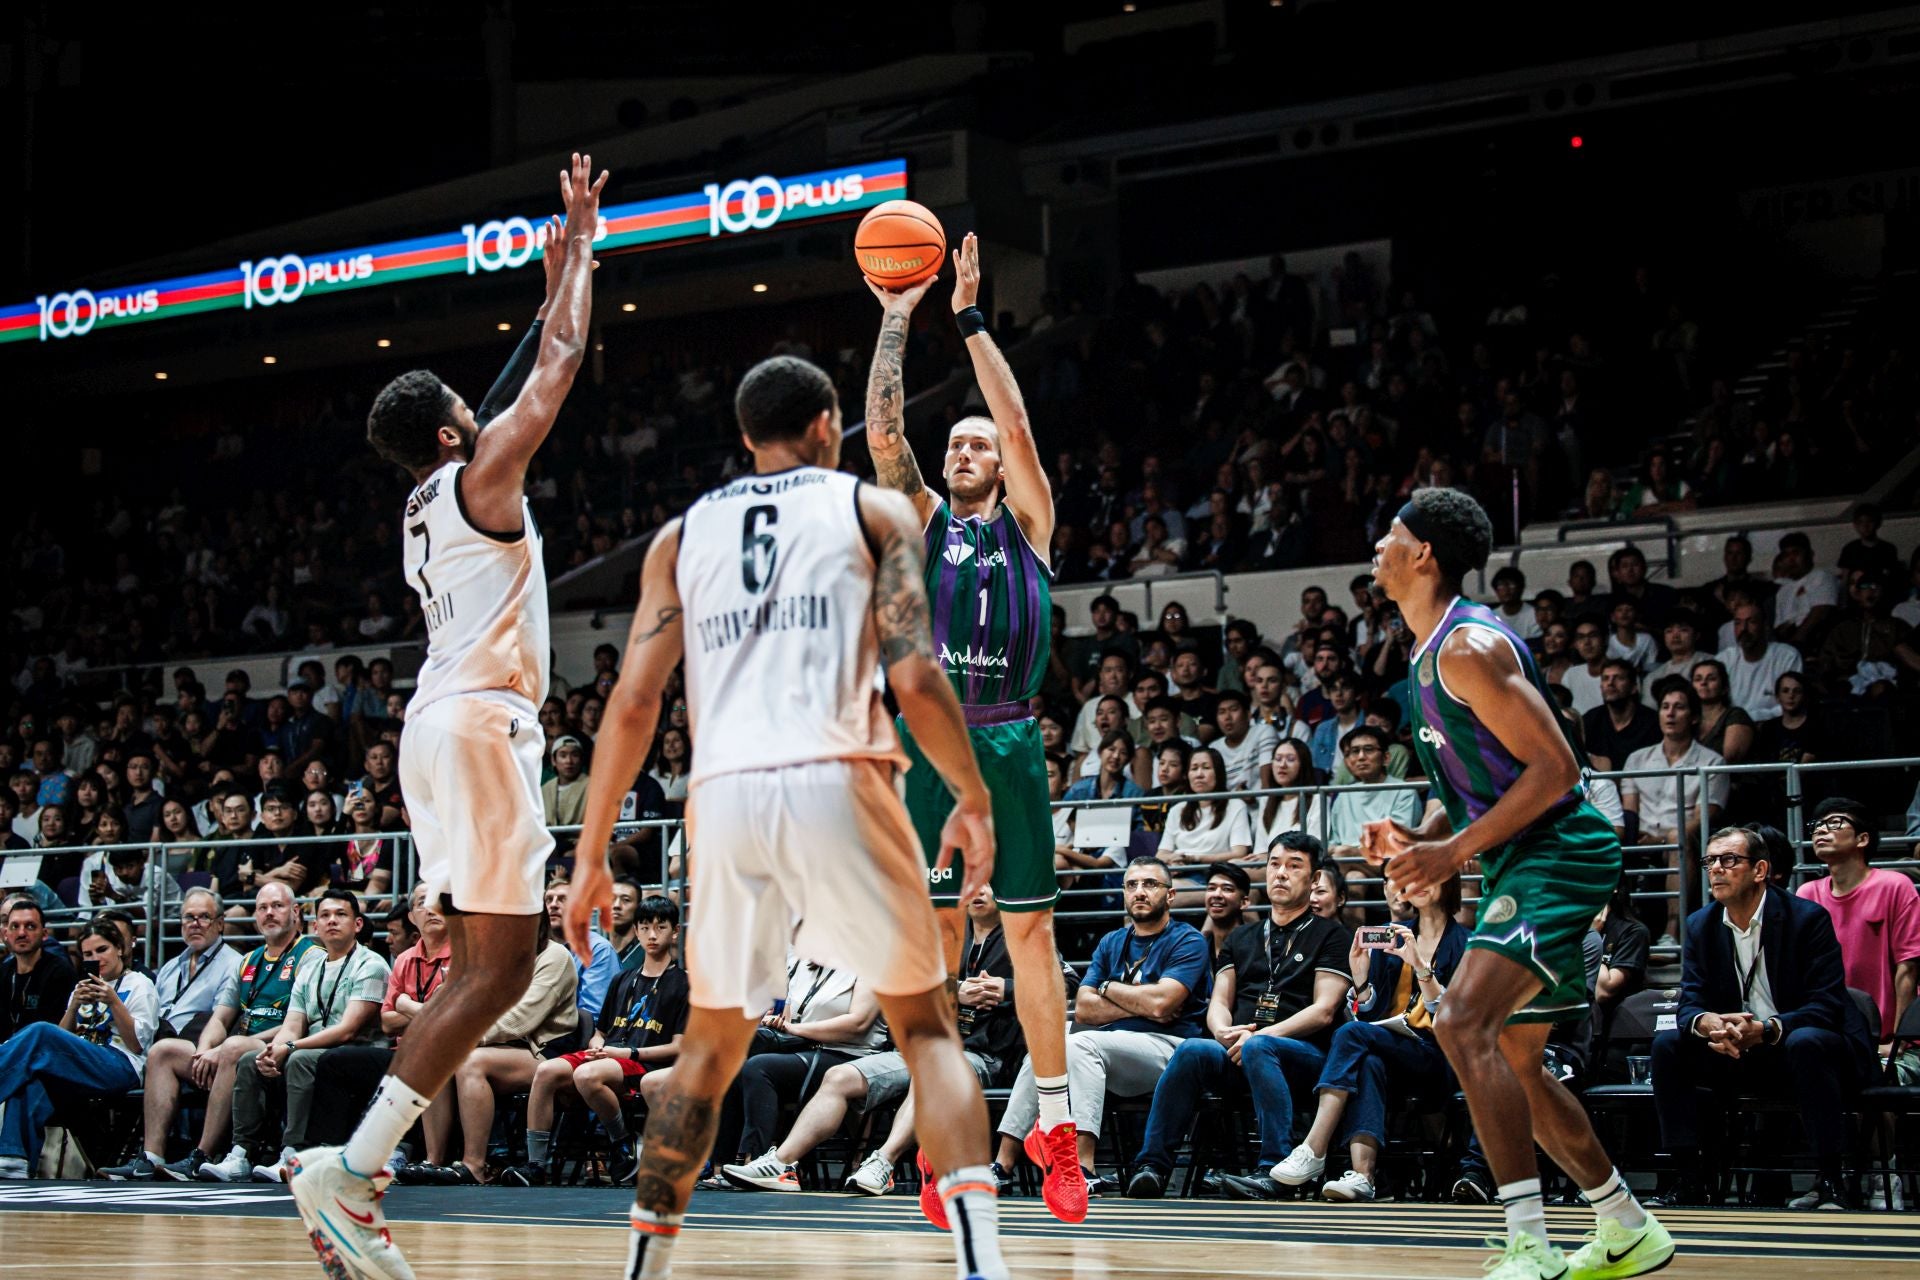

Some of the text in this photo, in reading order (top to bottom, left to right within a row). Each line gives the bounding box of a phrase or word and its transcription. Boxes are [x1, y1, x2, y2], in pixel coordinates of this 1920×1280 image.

[703, 173, 864, 236] 100 PLUS
[461, 215, 608, 275] 100 PS
[864, 253, 923, 273] Wilson
[240, 254, 374, 309] 100 PLUS
[36, 289, 159, 341] 100 PLUS
[409, 520, 434, 600] 7
[742, 504, 778, 594] 6
[978, 588, 988, 627] 1
